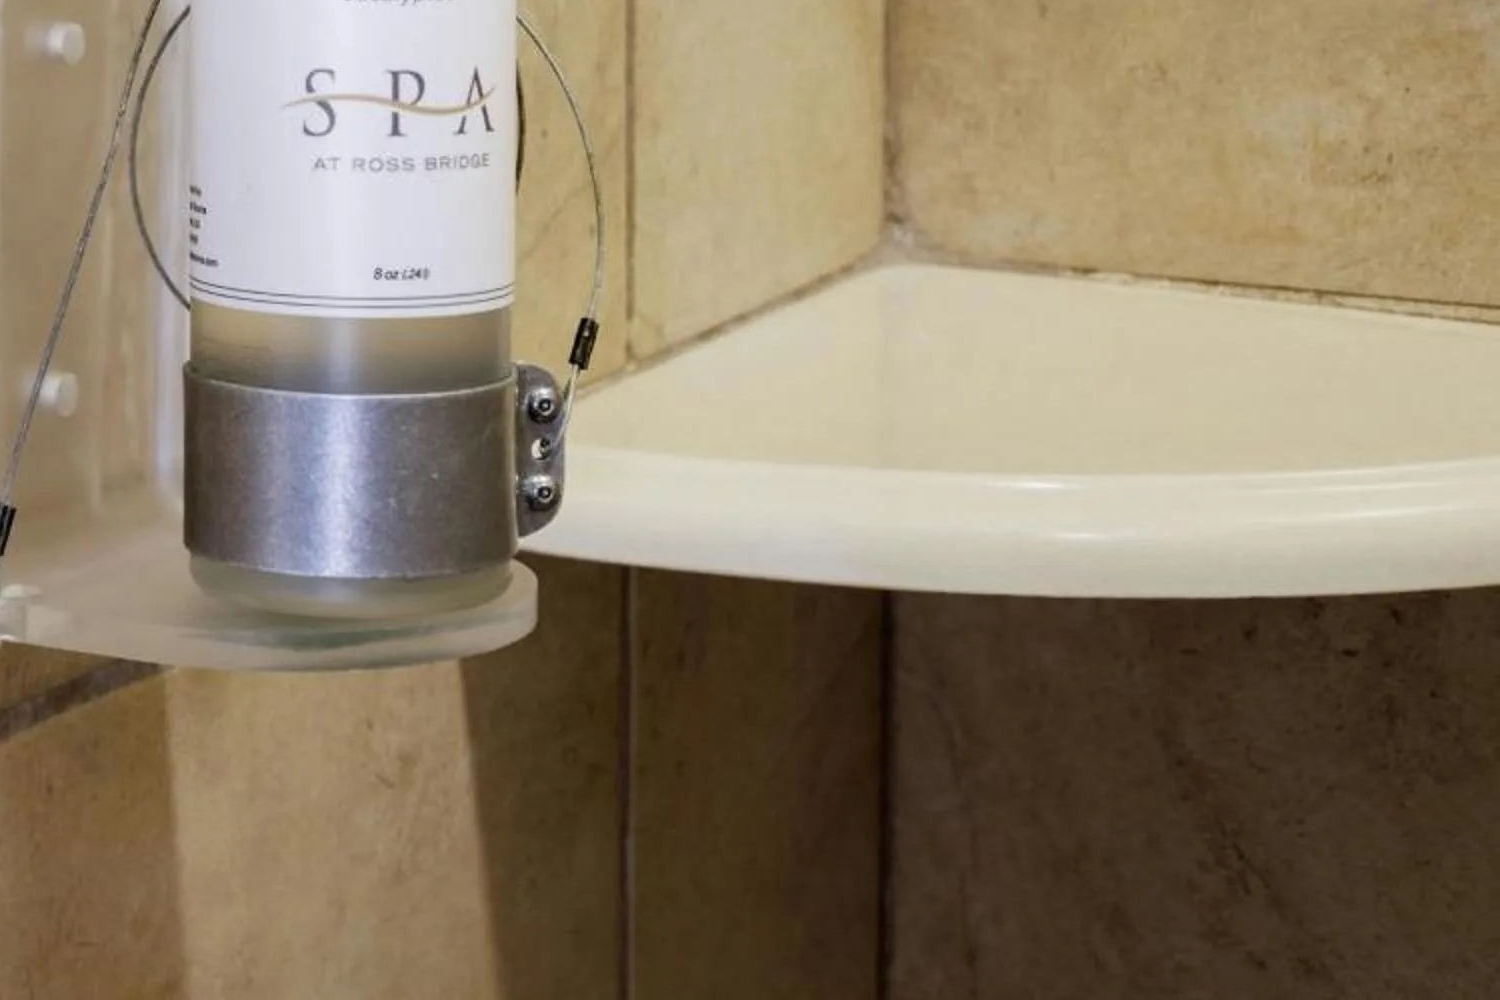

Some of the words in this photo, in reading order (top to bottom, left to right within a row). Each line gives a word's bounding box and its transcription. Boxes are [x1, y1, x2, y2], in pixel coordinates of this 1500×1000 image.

[311, 156, 341, 172] AT
[351, 156, 417, 174] ROSS
[424, 153, 491, 172] BRIDGE
[373, 267, 384, 281] 8
